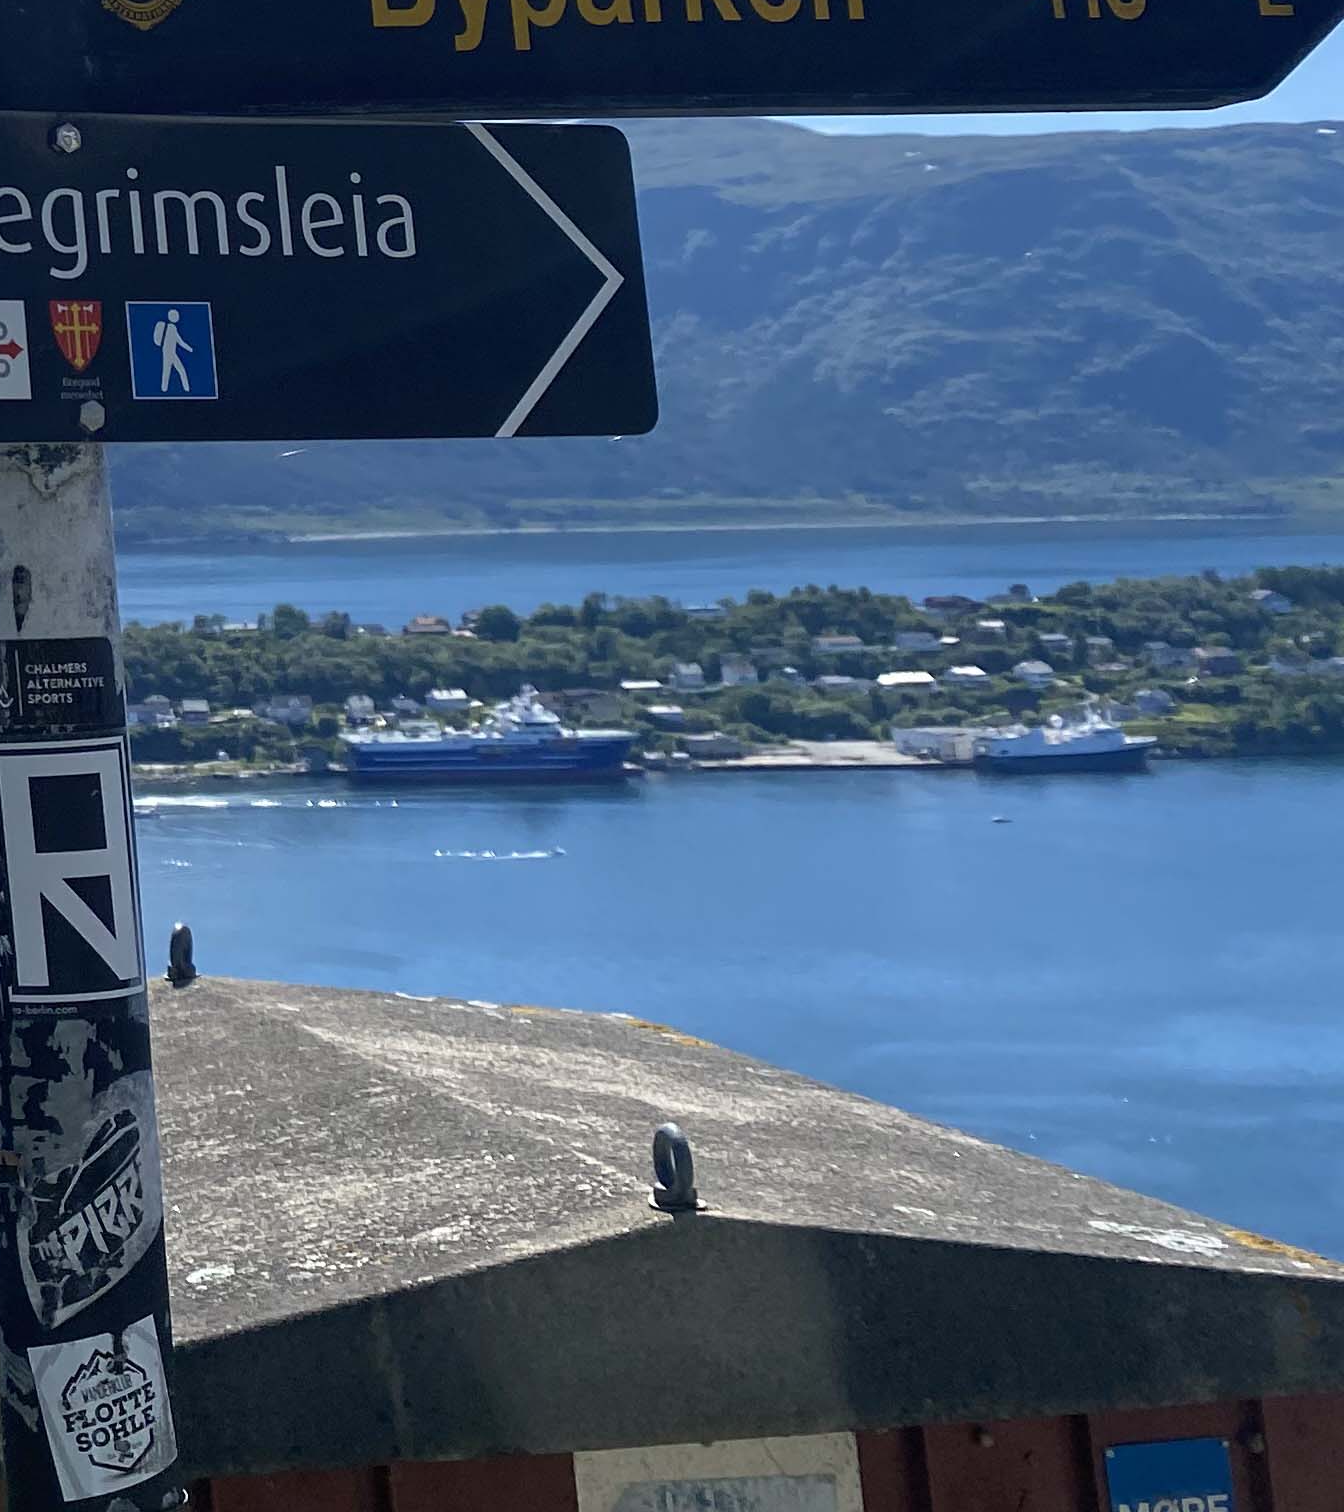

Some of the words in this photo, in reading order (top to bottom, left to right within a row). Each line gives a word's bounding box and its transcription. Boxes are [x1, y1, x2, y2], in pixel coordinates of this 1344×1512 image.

[25, 662, 88, 675] CHALMERS
[27, 675, 105, 690] ALTERNATIVE
[28, 691, 73, 704] SPORTS
[62, 1380, 156, 1433] FLOTTE
[75, 1405, 156, 1452] SOHLE
[1118, 1493, 1229, 1512] RE
